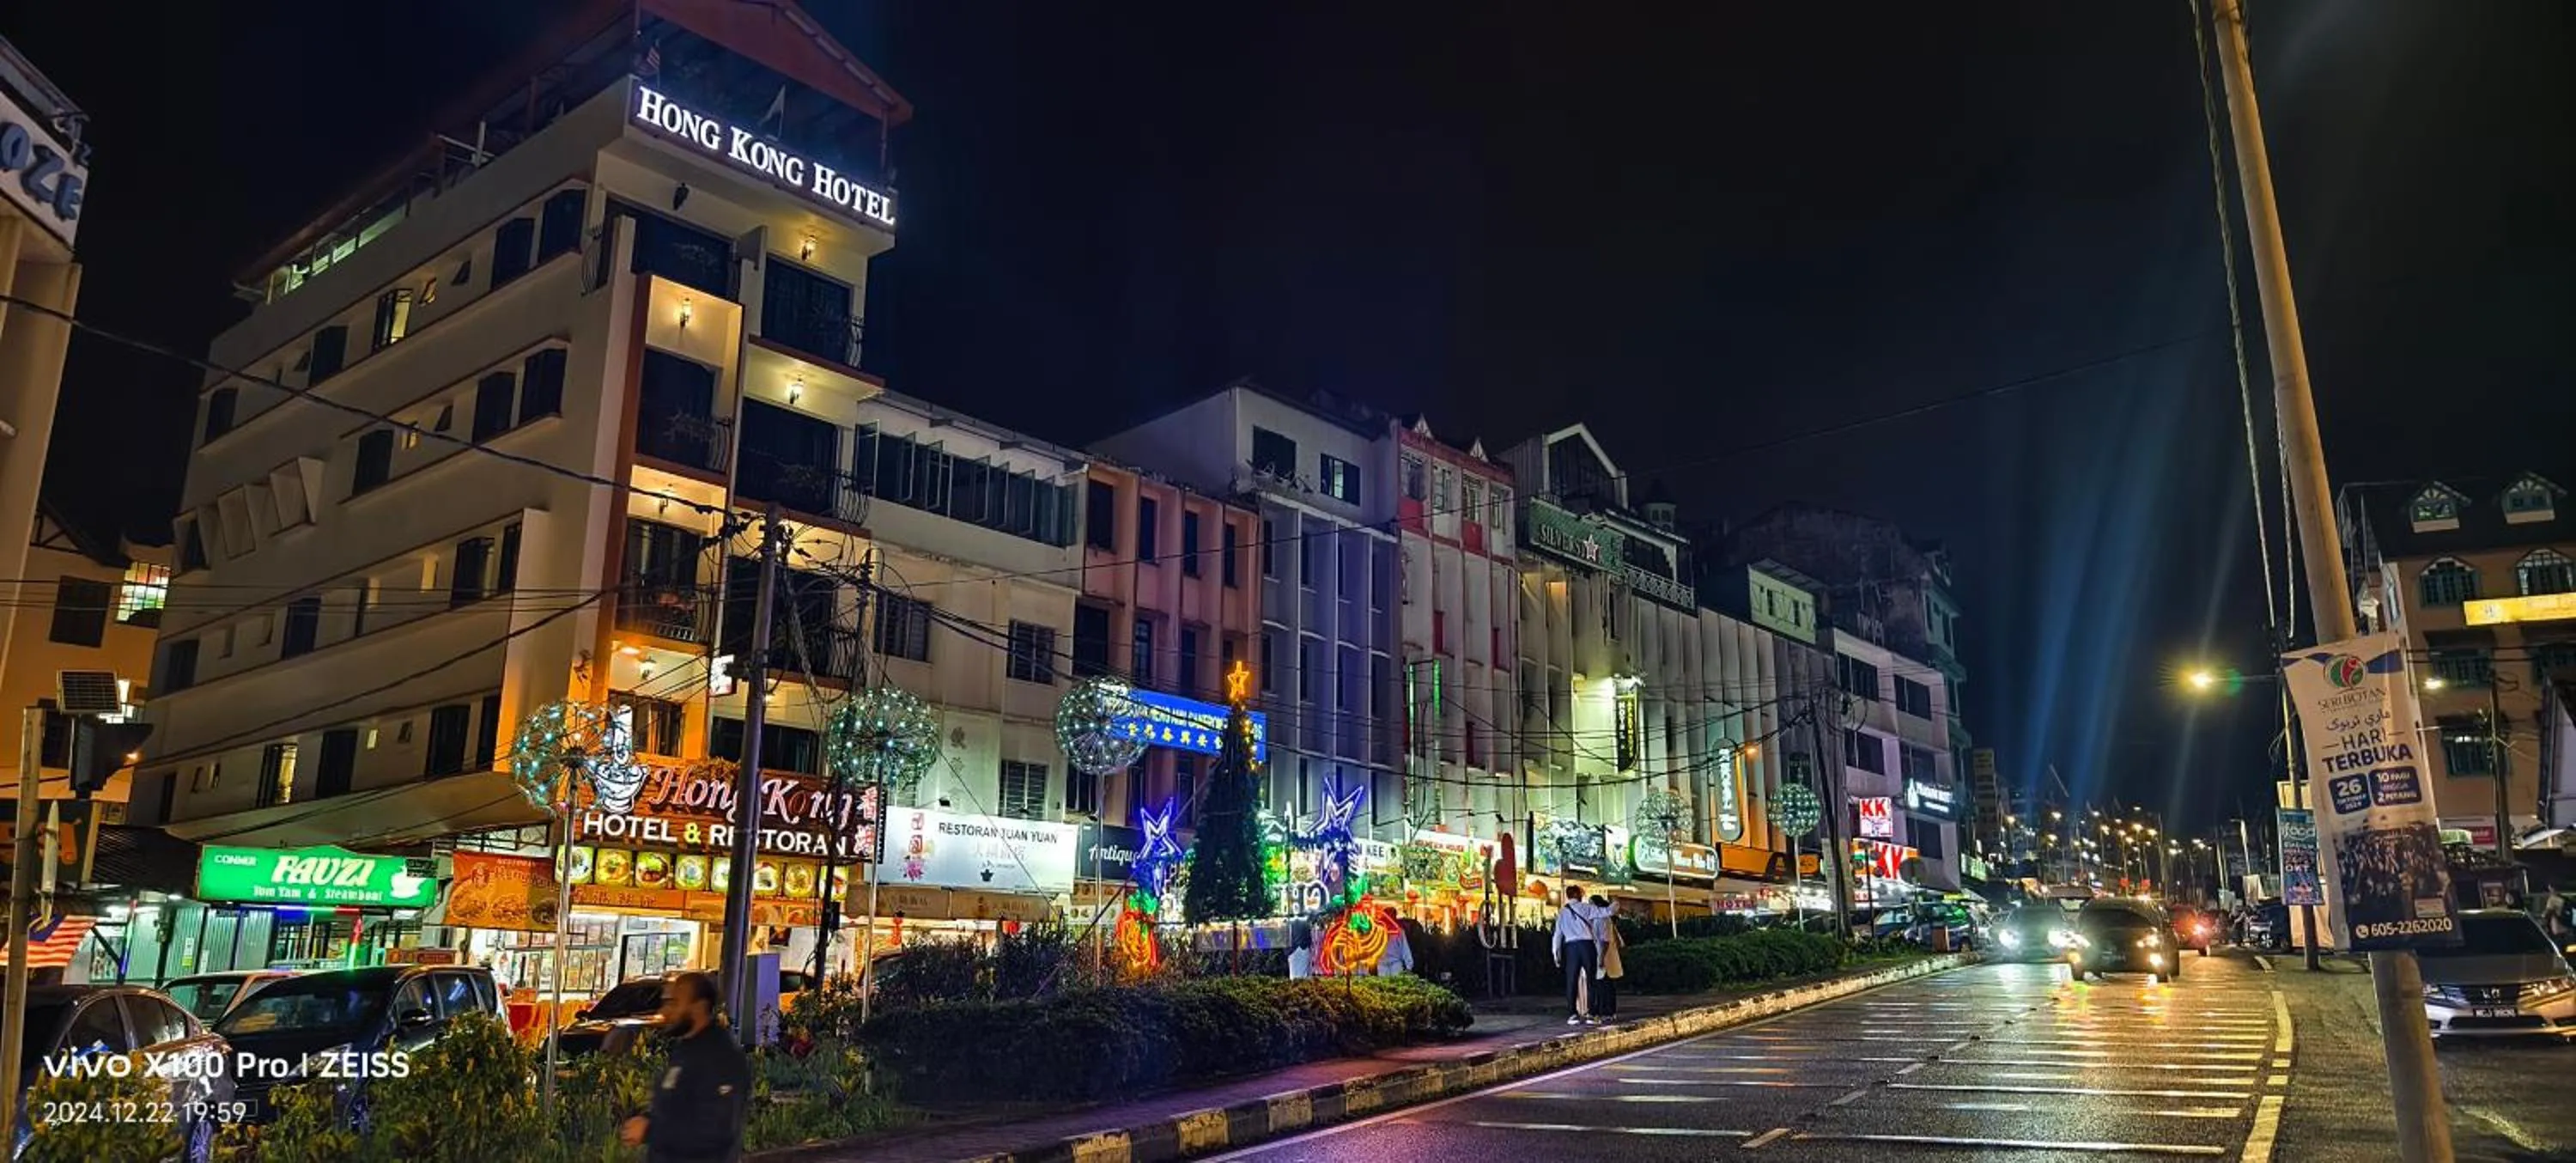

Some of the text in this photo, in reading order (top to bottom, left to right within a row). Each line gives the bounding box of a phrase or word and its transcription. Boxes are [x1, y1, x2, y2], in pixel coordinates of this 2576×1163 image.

[637, 86, 896, 226] HONG KONG HOTEL
[2342, 728, 2387, 750] HARI
[2322, 744, 2413, 773] TERBUKA
[2336, 779, 2361, 797] 26
[2377, 772, 2390, 784] 10
[1861, 799, 1886, 816] KK
[583, 813, 846, 857] HOTEL & RTORAN
[938, 822, 999, 838] RESTORAN
[1030, 831, 1058, 844] YUAN
[271, 855, 375, 886] FAUZI
[2371, 916, 2452, 937] 605-2262020
